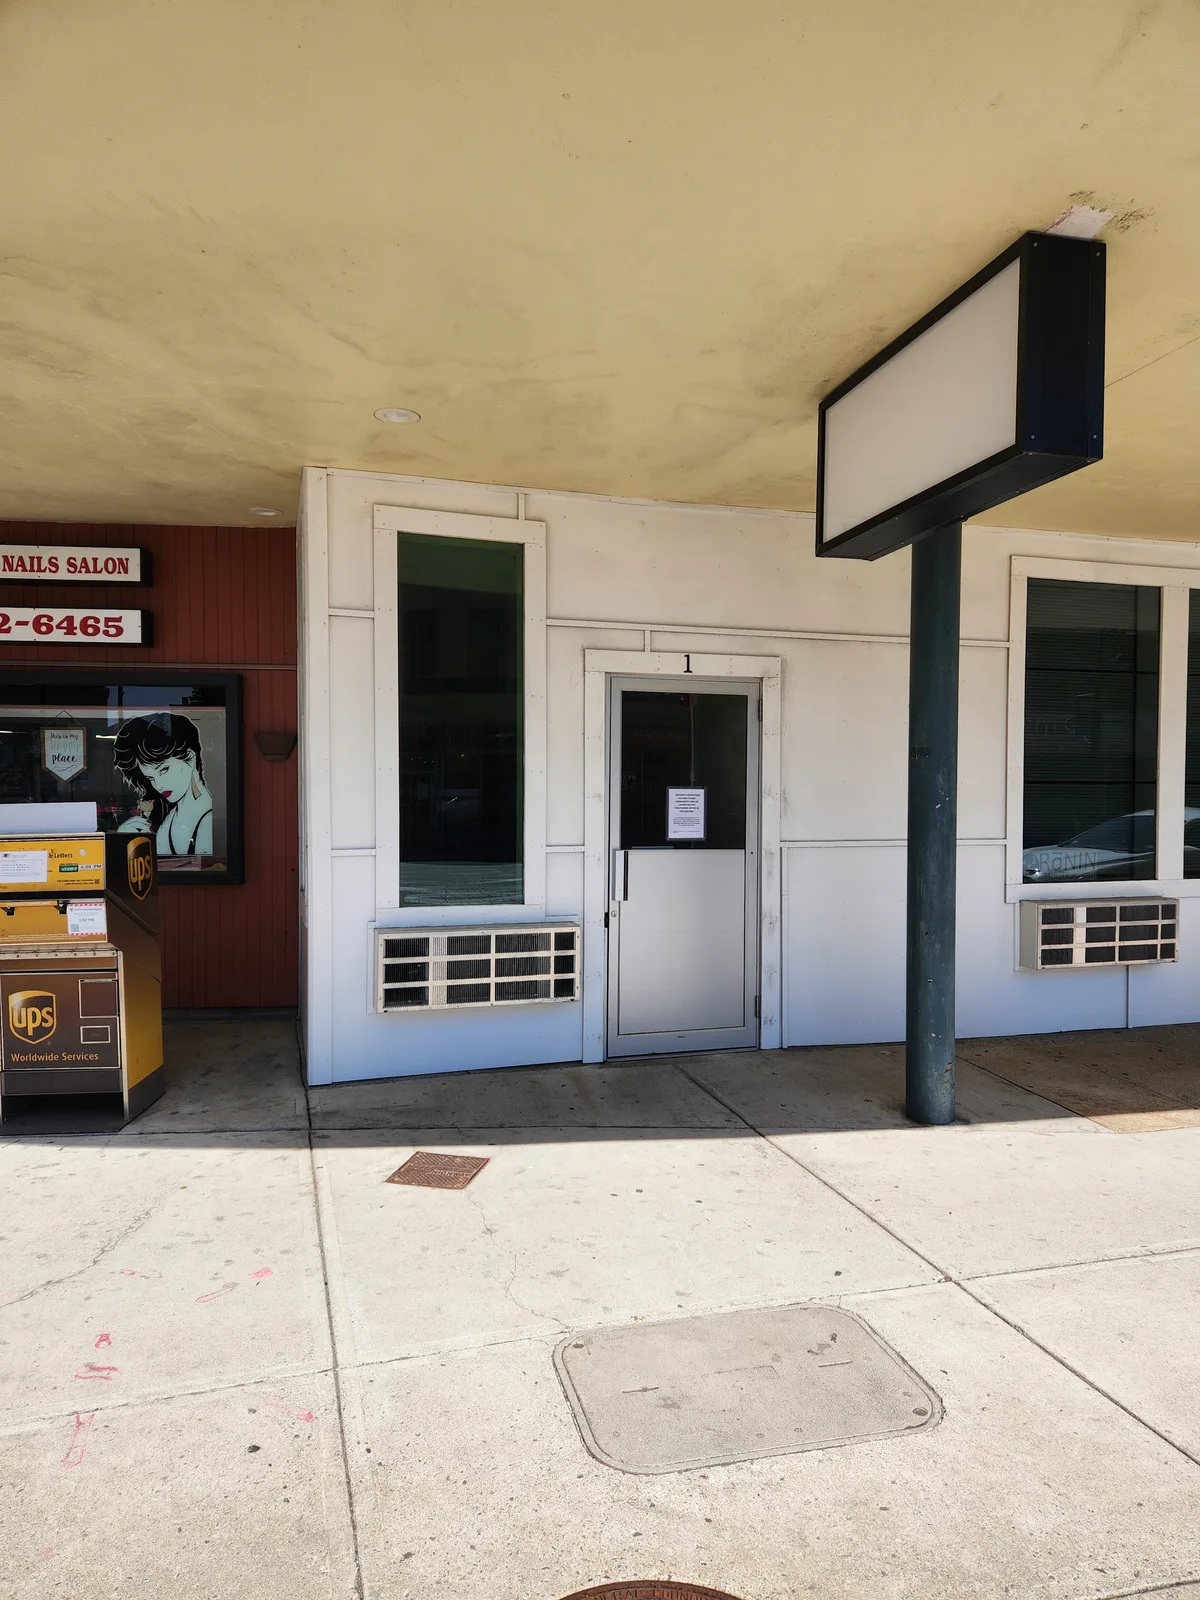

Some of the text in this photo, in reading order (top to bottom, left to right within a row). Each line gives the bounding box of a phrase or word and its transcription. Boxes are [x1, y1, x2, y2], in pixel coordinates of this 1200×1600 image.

[2, 555, 129, 575] NAILS SALON
[683, 654, 693, 674] 1
[50, 732, 79, 741] This is my
[52, 752, 78, 765] place
[130, 855, 151, 891] ups
[12, 1006, 54, 1036] ups
[10, 1052, 99, 1062] Worldwide Services
